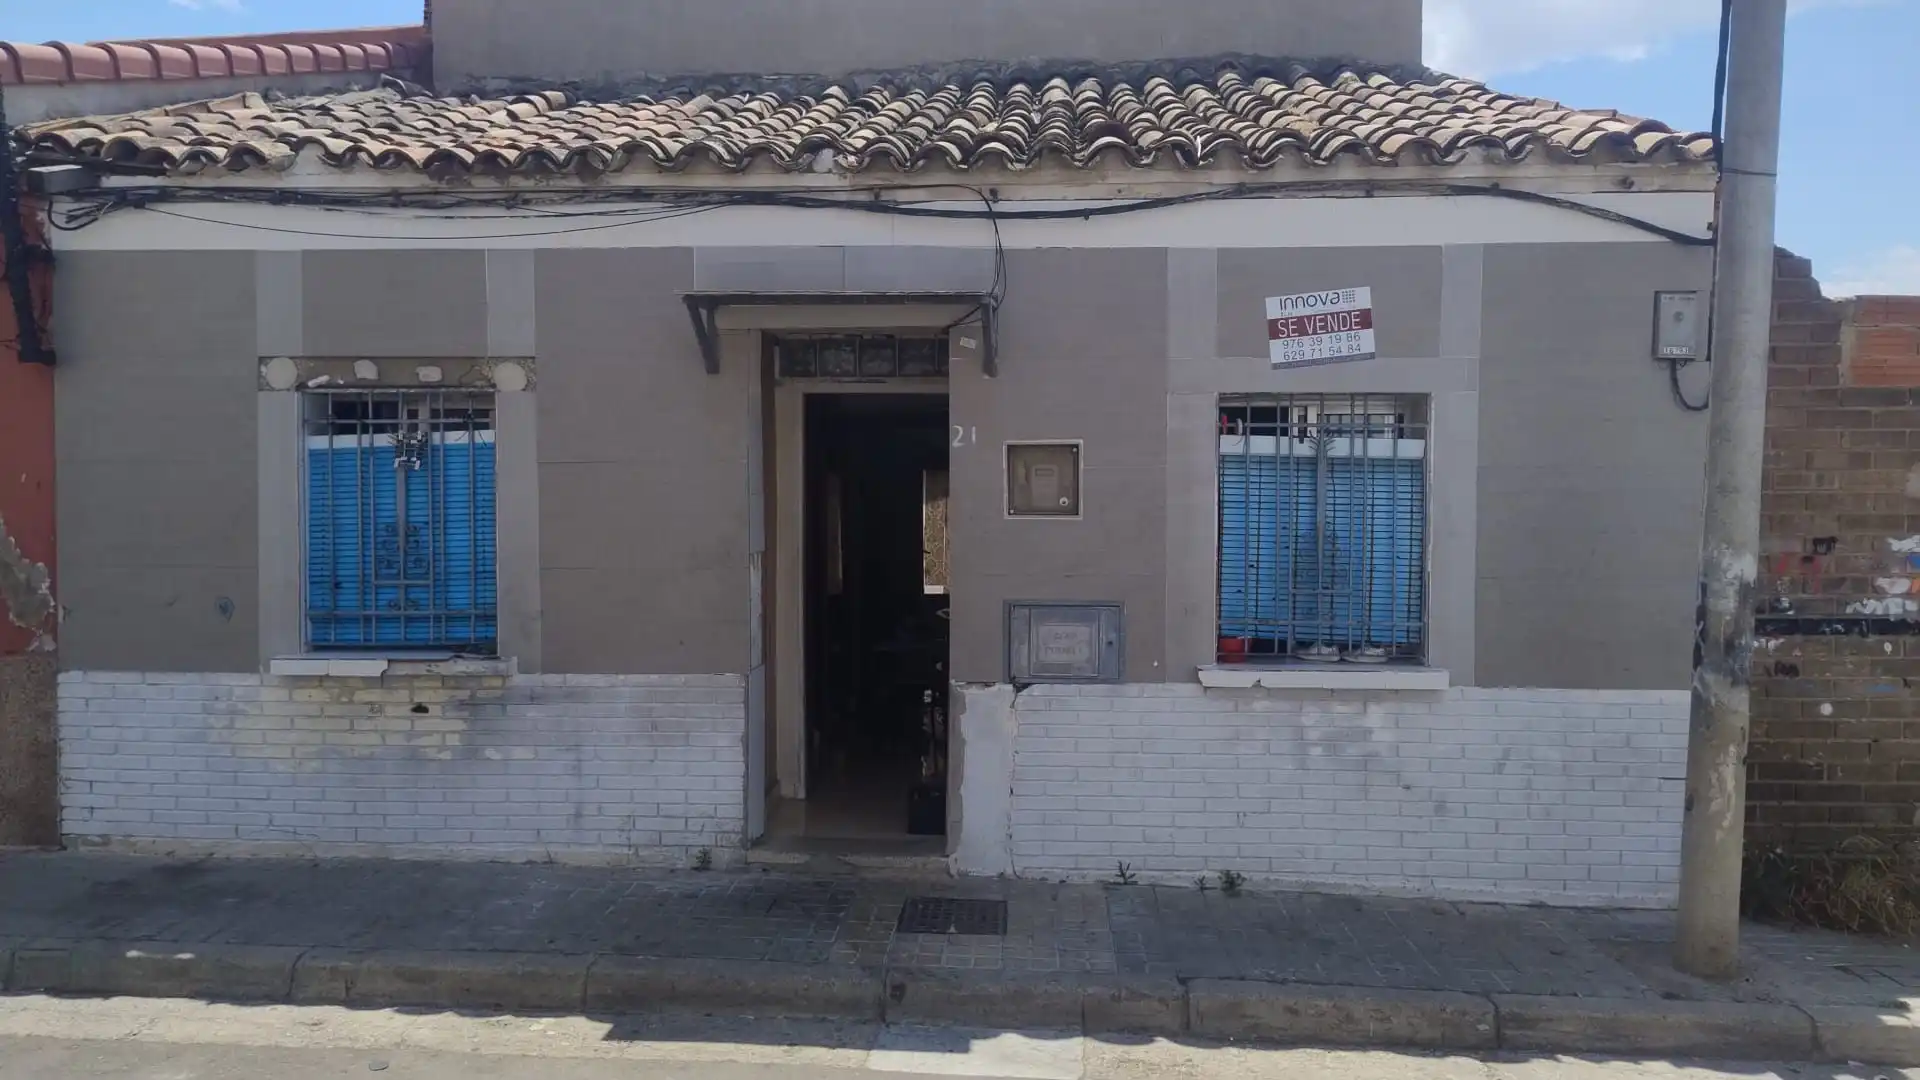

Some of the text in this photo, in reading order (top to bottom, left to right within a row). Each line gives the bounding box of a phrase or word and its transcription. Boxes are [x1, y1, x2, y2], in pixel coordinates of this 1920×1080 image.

[1279, 290, 1341, 310] innova
[1277, 311, 1362, 337] SE VENDE
[1281, 331, 1361, 349] 976 39 19 86
[1283, 349, 1305, 361] 629
[1310, 348, 1323, 359] 71
[1328, 346, 1342, 356] 54
[952, 425, 976, 447] 21
